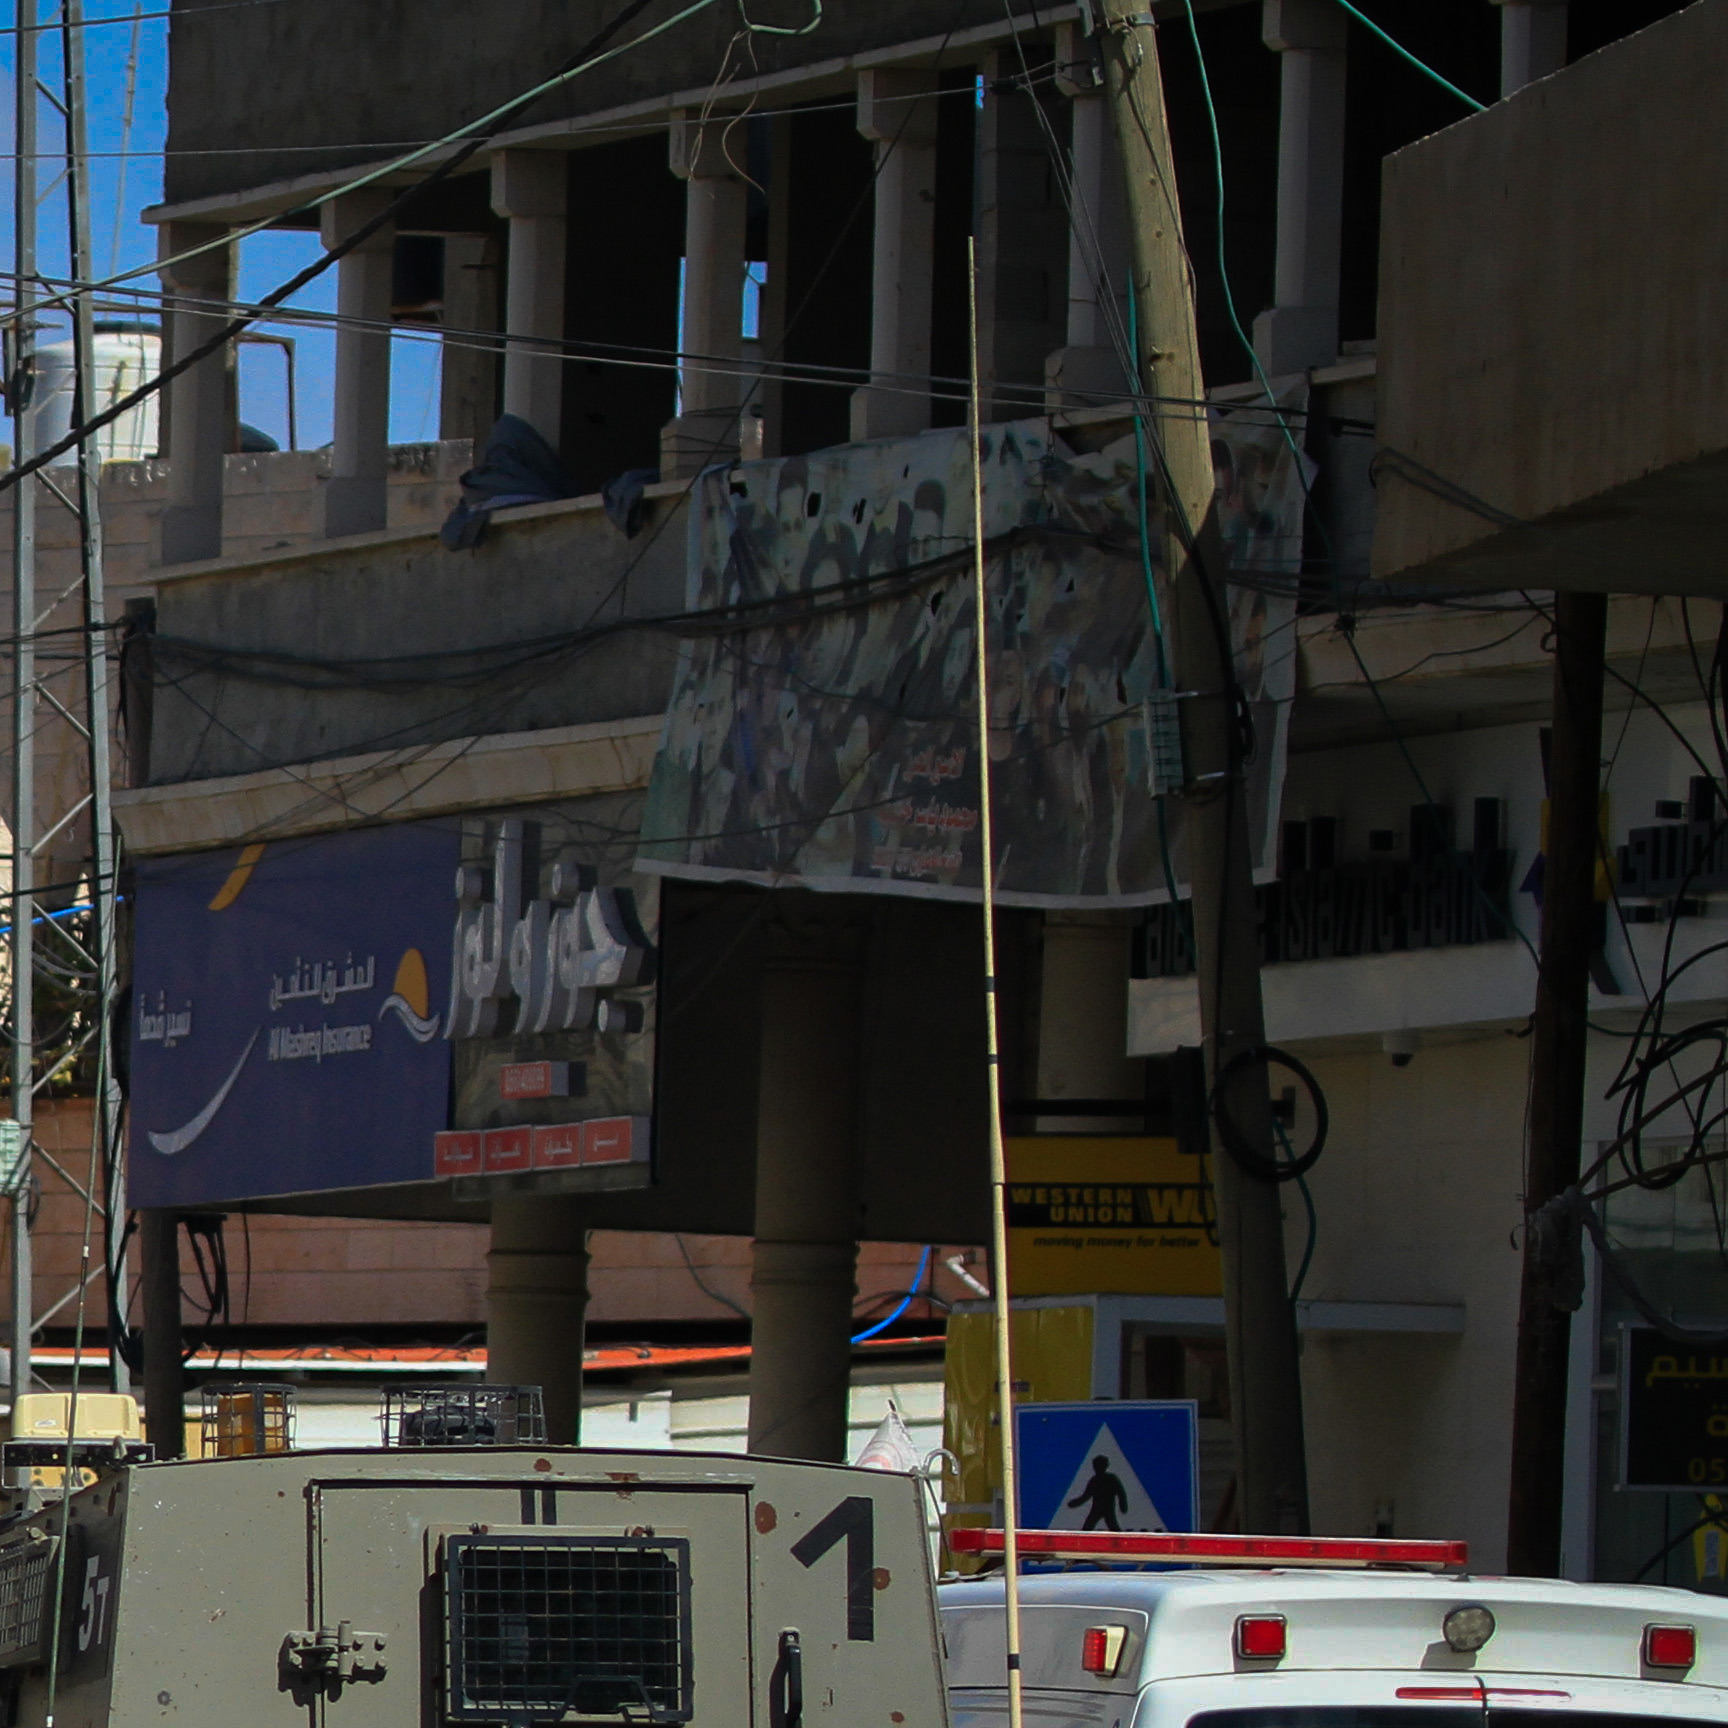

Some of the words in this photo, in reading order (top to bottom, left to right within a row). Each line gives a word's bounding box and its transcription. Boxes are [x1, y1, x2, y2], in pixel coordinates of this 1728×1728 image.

[268, 1027, 280, 1061] Al
[281, 1024, 322, 1063] Mashreq
[323, 1022, 372, 1055] Insurance
[1011, 1187, 1134, 1204] WESTERN
[1049, 1205, 1134, 1223] UNION
[1033, 1236, 1083, 1250] moving
[1087, 1237, 1134, 1250] money
[1137, 1235, 1155, 1247] for
[1159, 1235, 1201, 1247] better
[790, 1496, 875, 1641] 1
